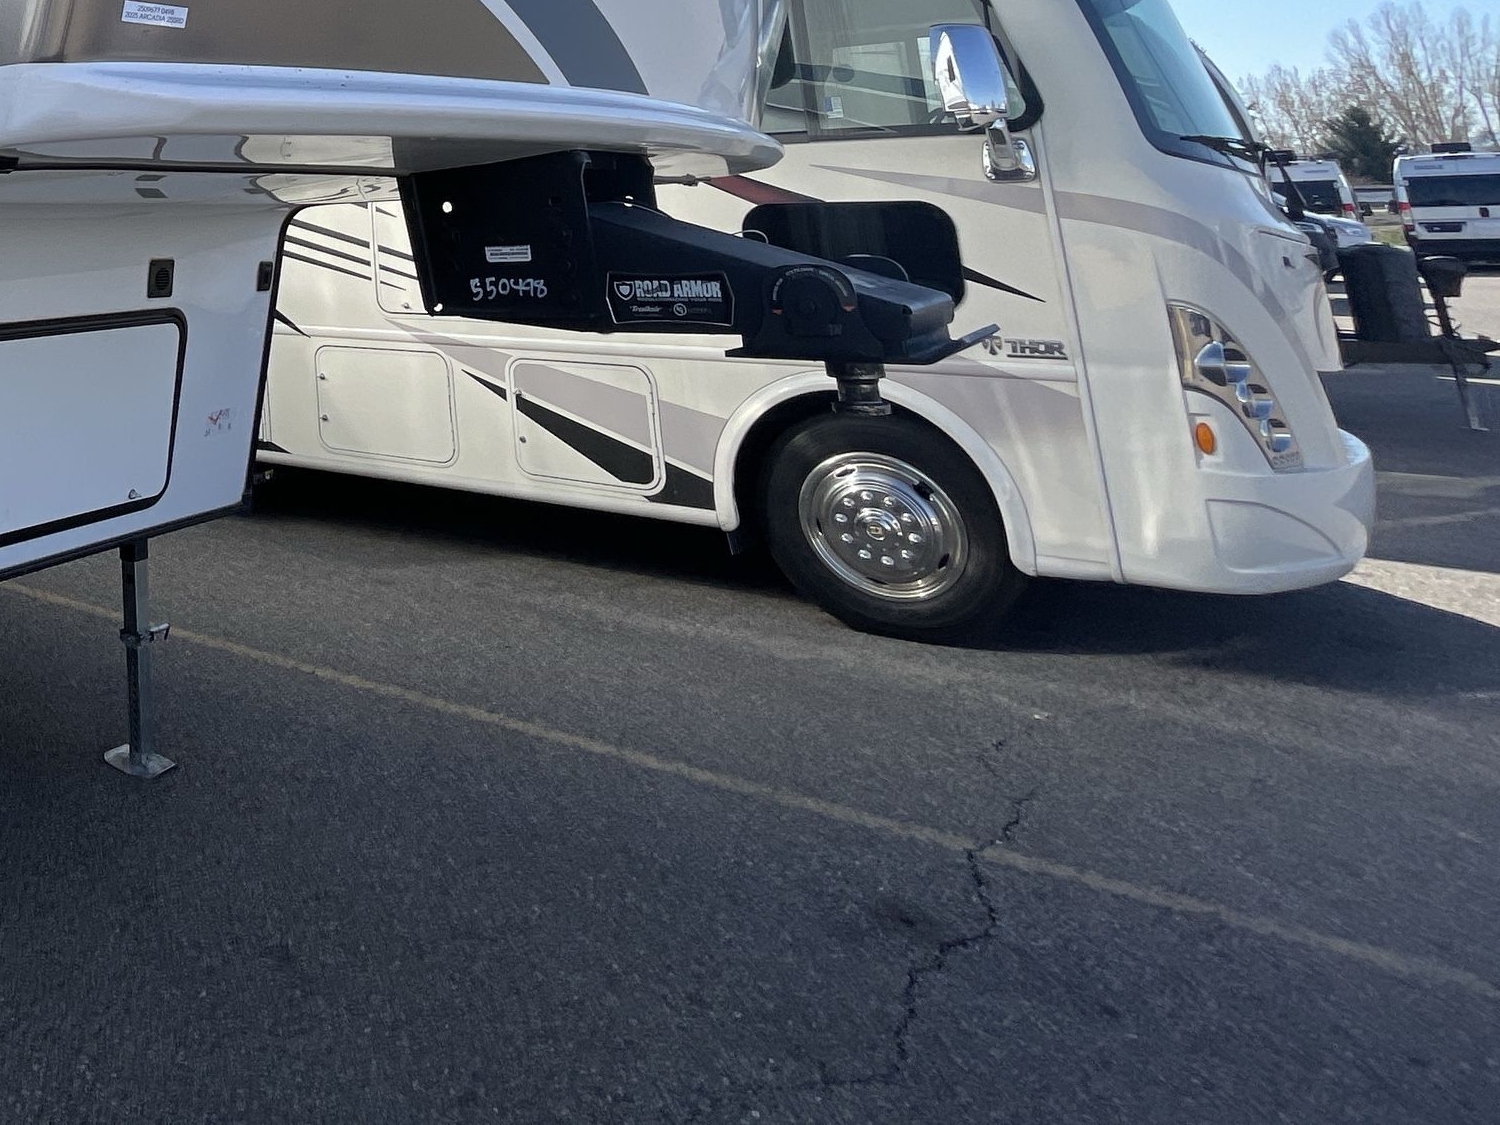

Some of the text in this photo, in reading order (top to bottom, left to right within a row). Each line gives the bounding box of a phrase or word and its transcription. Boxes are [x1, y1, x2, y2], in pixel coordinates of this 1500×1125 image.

[470, 277, 548, 302] 550498
[634, 280, 722, 298] ROAD ARMOR
[1004, 338, 1067, 355] THOR
